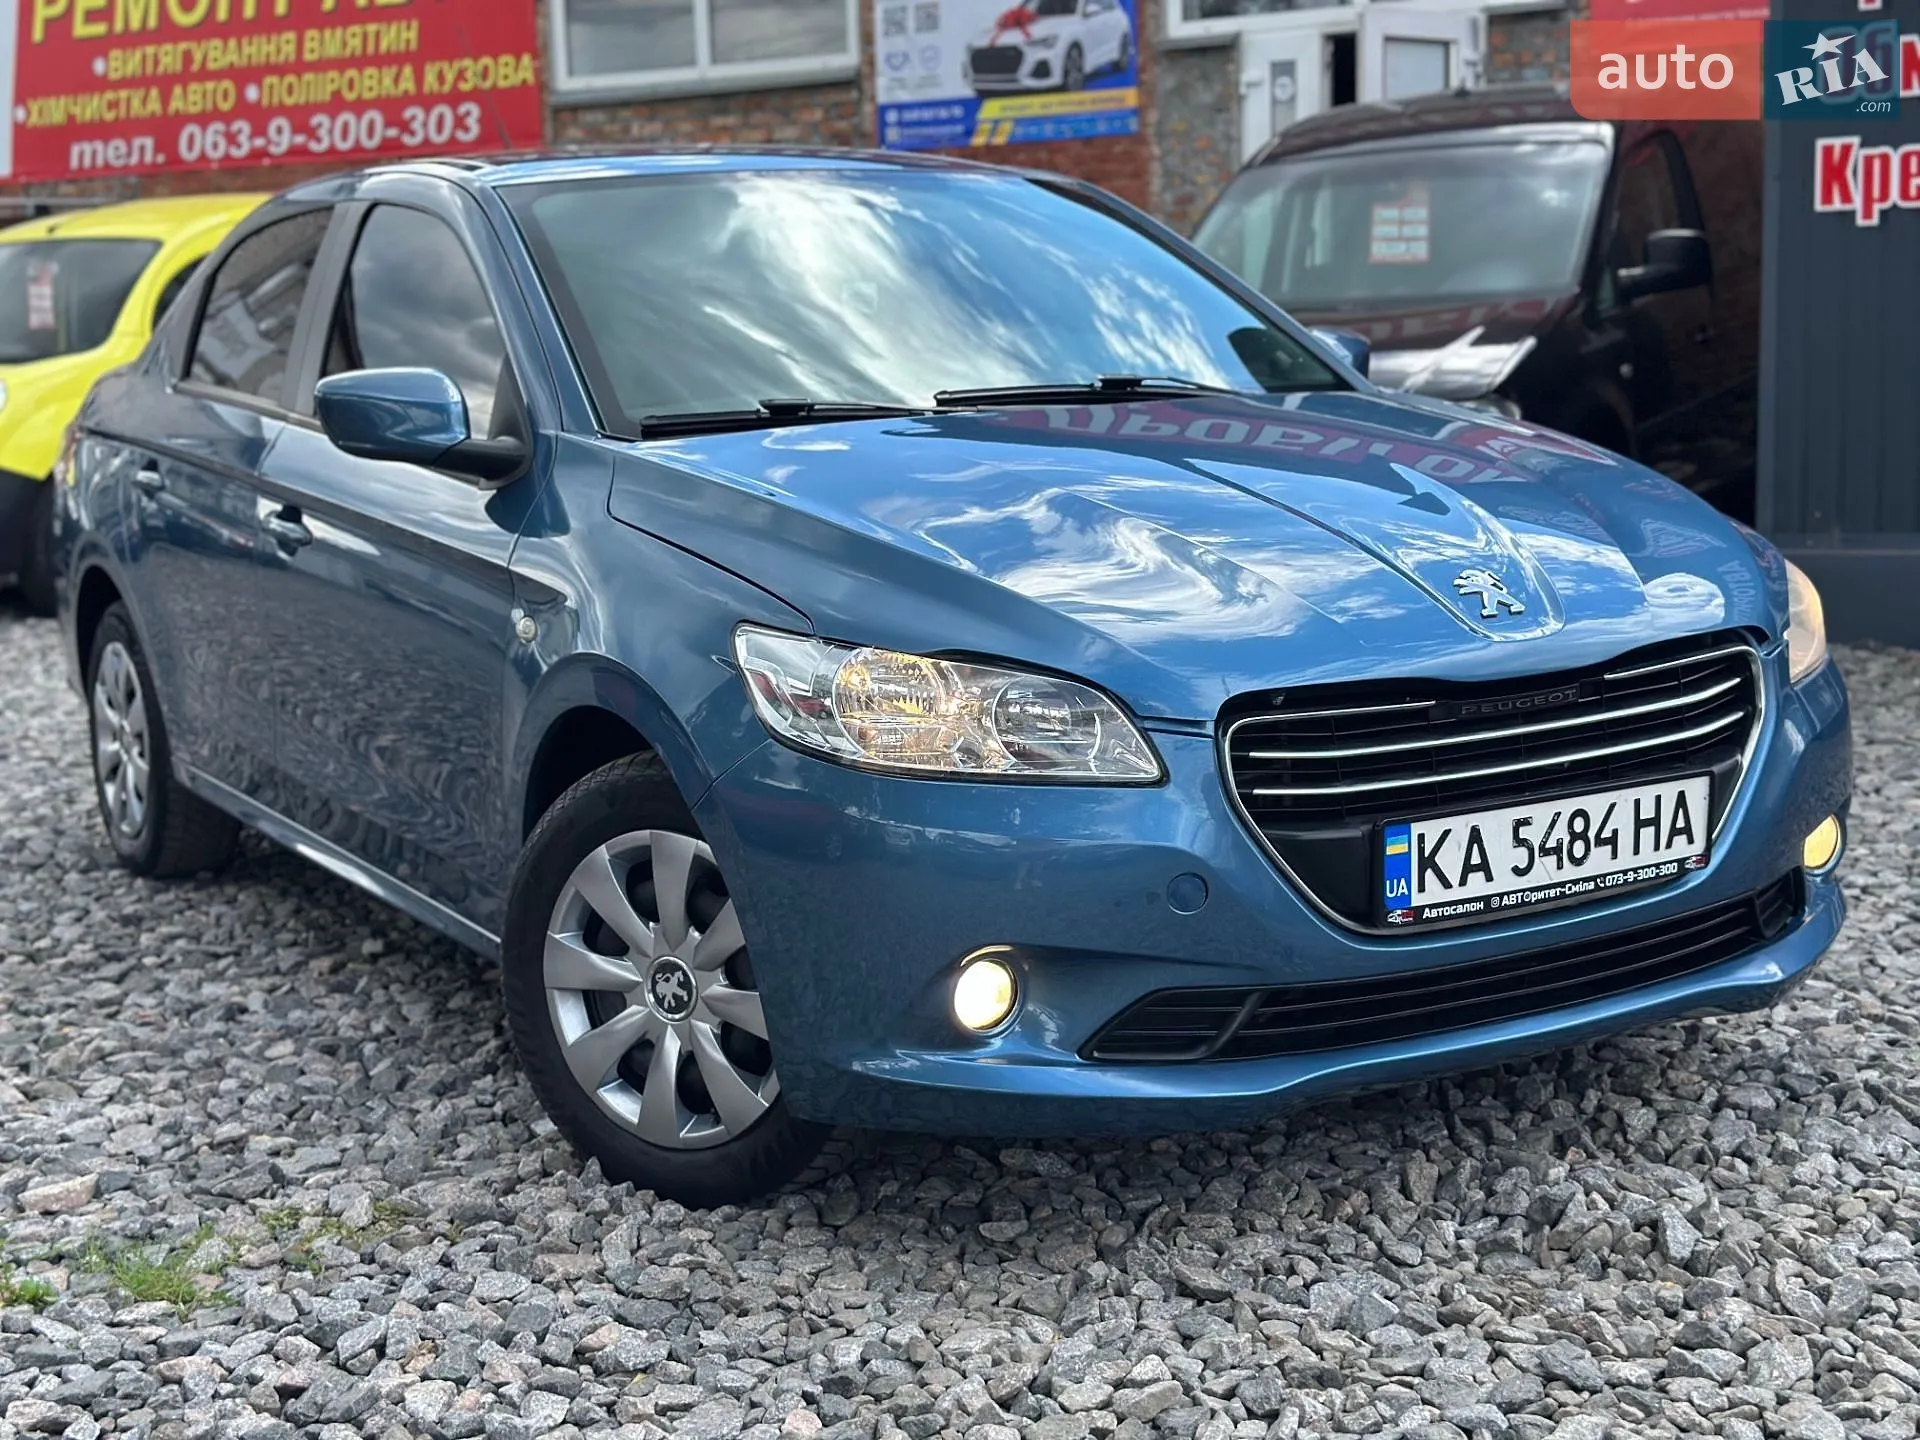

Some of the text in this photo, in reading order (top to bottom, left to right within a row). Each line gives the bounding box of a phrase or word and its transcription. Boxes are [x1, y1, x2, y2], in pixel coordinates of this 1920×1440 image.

[107, 19, 419, 81] ВИТЯГУВАННЯ ВМЯТИН
[26, 86, 163, 128] ХІМЧИСТКА
[168, 79, 236, 115] АВТО
[423, 53, 536, 95] КУЗОВА
[69, 101, 482, 170] тел. 063-9-300-303
[1461, 688, 1577, 714] PEUGEOT
[1417, 789, 1695, 893] KA 5484 HA
[1385, 877, 1409, 898] UA
[1422, 900, 1484, 920] Автосалон
[1605, 862, 1678, 887] 073-9-300-300
